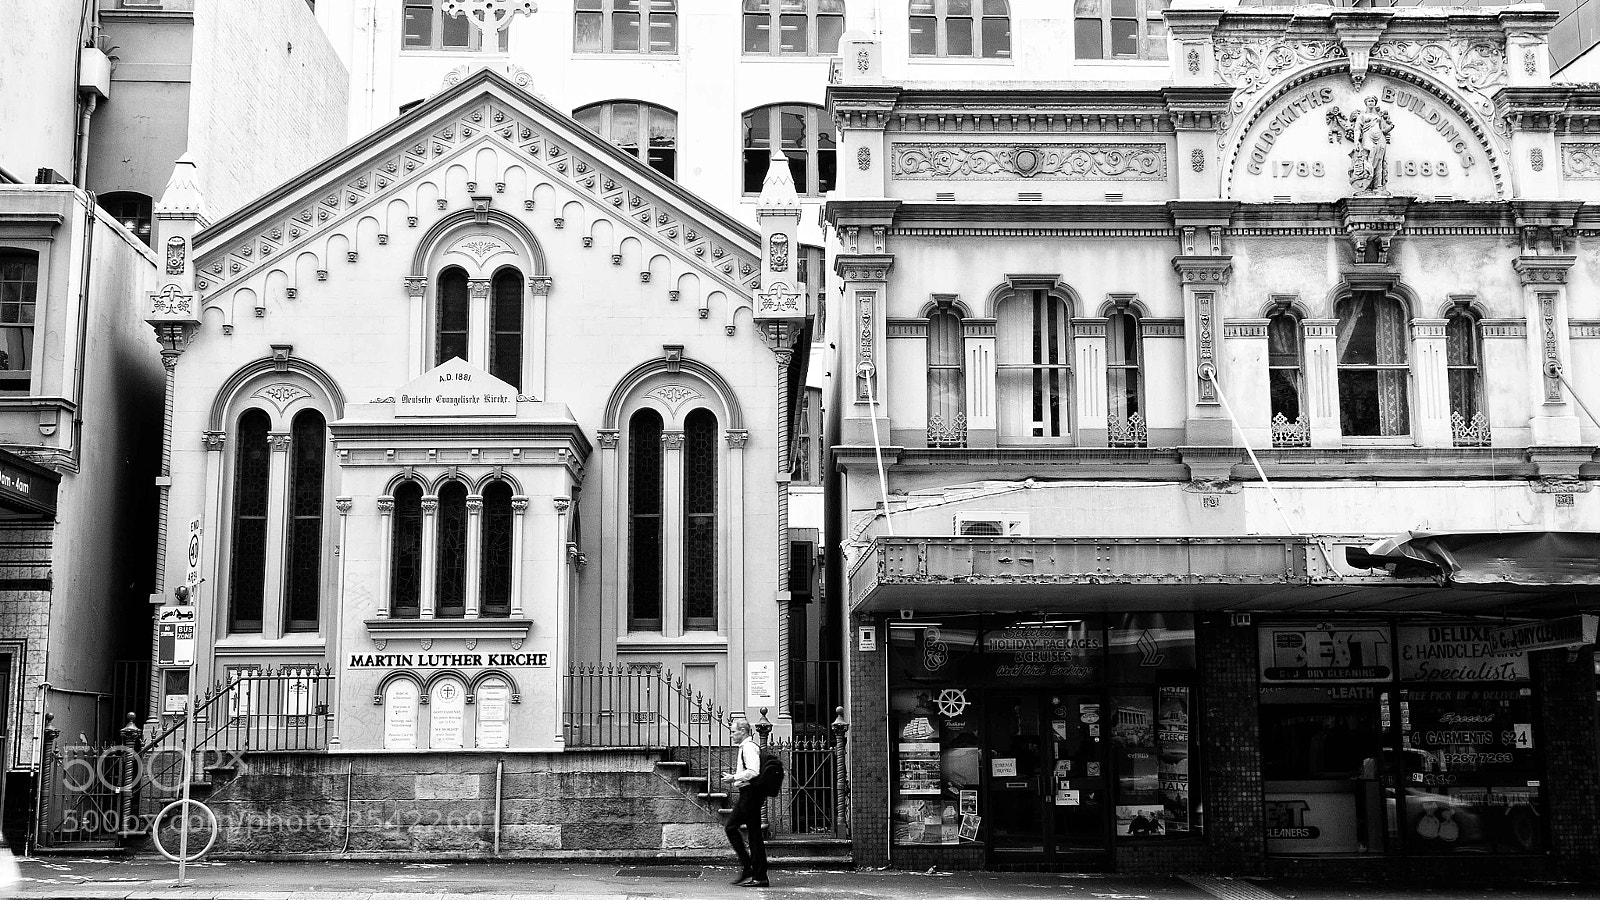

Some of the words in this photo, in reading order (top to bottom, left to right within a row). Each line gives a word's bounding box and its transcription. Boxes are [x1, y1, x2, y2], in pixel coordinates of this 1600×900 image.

[1247, 87, 1334, 175] GOLDSMITHS
[1272, 161, 1326, 178] 1788
[1396, 160, 1449, 177] 1888
[16, 477, 29, 494] 4am
[989, 639, 1038, 650] HOLIDAY
[1043, 639, 1099, 649] PACKAGES
[1273, 630, 1388, 667] BEST
[350, 654, 413, 667] MARTIN
[418, 654, 483, 667] LUTHER
[488, 653, 548, 666] KIRCHE
[1307, 669, 1325, 678] DRY
[1328, 668, 1376, 678] CLEANING
[1414, 661, 1517, 681] Specialists
[1159, 732, 1188, 742] GREECE
[1411, 731, 1421, 745] 4
[1426, 731, 1493, 745] GARMENTS
[1444, 752, 1477, 763] 9267
[1479, 752, 1514, 763] 7263
[1160, 782, 1188, 791] ITALY
